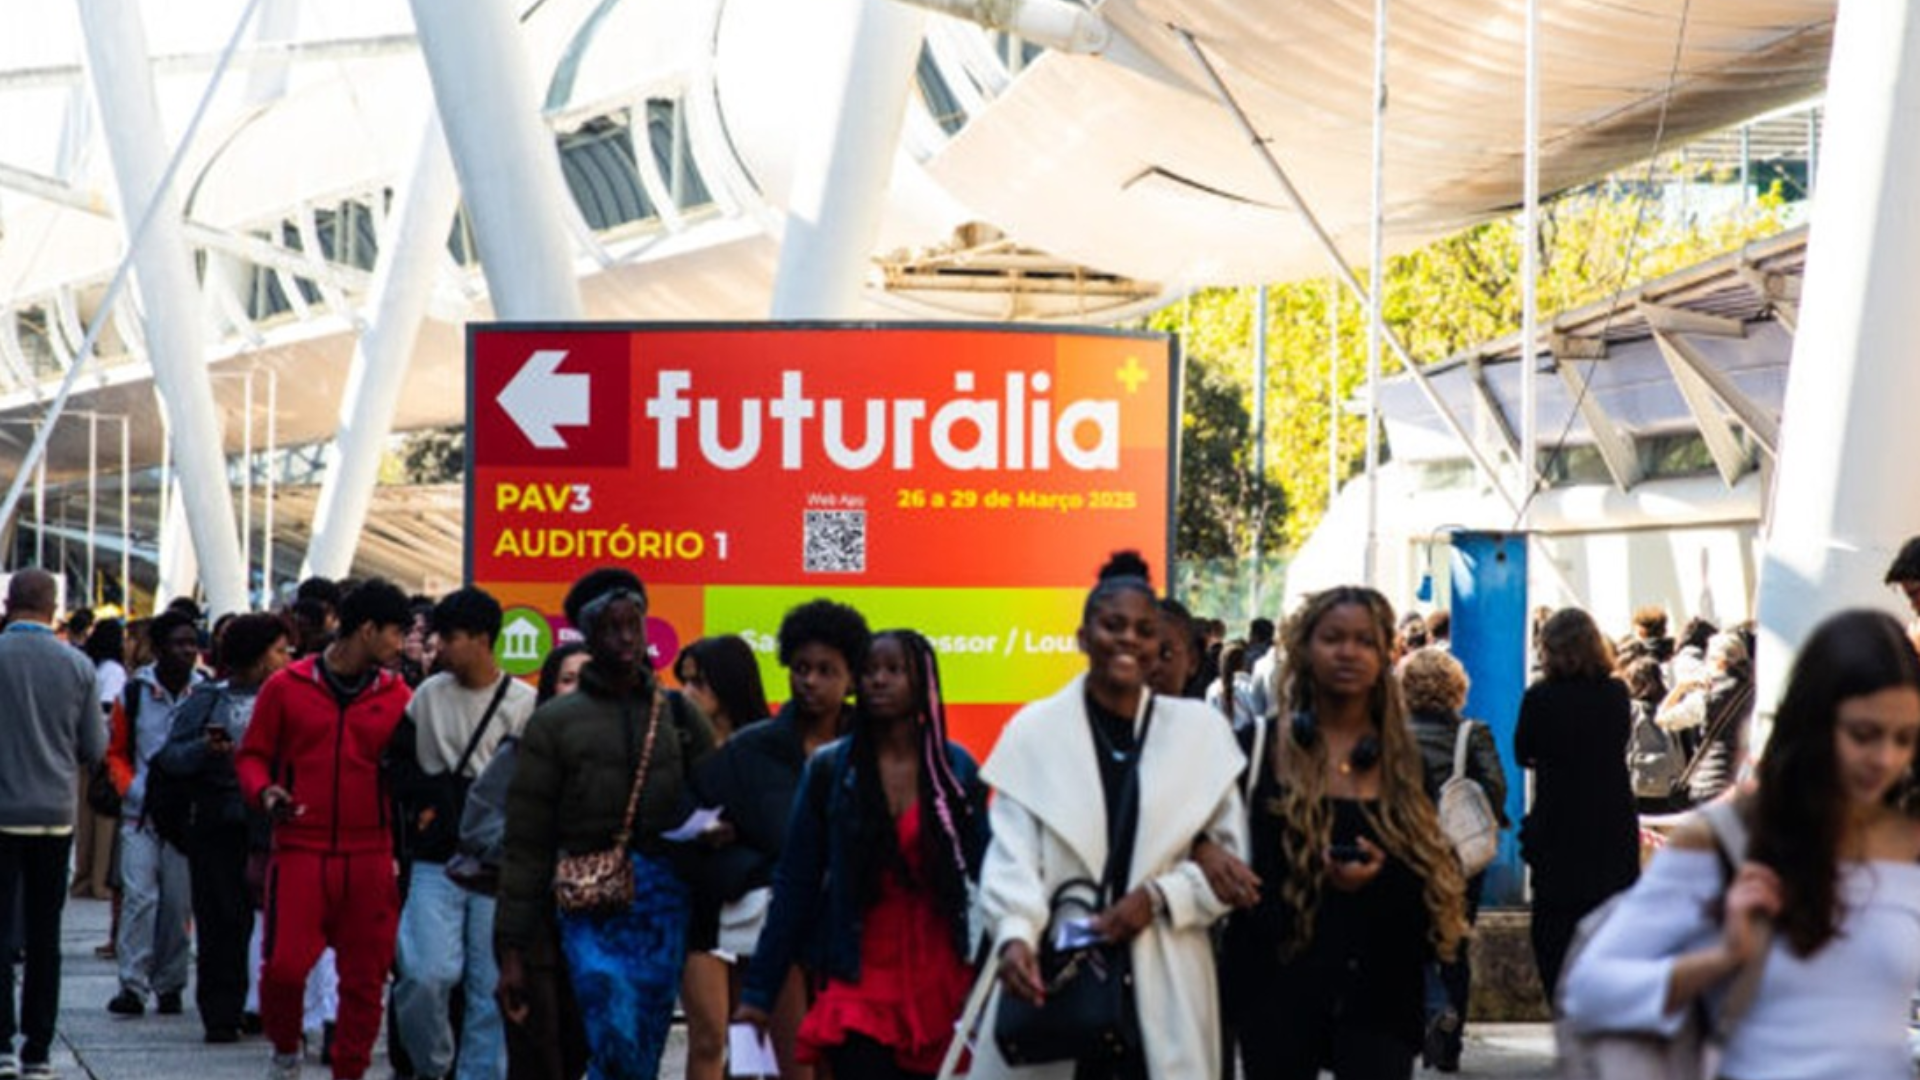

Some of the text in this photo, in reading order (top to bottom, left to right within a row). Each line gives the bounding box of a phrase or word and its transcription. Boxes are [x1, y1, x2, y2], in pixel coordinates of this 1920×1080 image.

[646, 370, 1120, 470] futurália
[496, 483, 592, 513] PAV3
[898, 489, 926, 508] 26
[931, 493, 945, 508] a
[951, 490, 978, 508] 29
[983, 490, 1012, 508] de
[1016, 490, 1083, 513] Março
[493, 523, 728, 560] AUDITÓRIO 1
[740, 629, 780, 653] Sa
